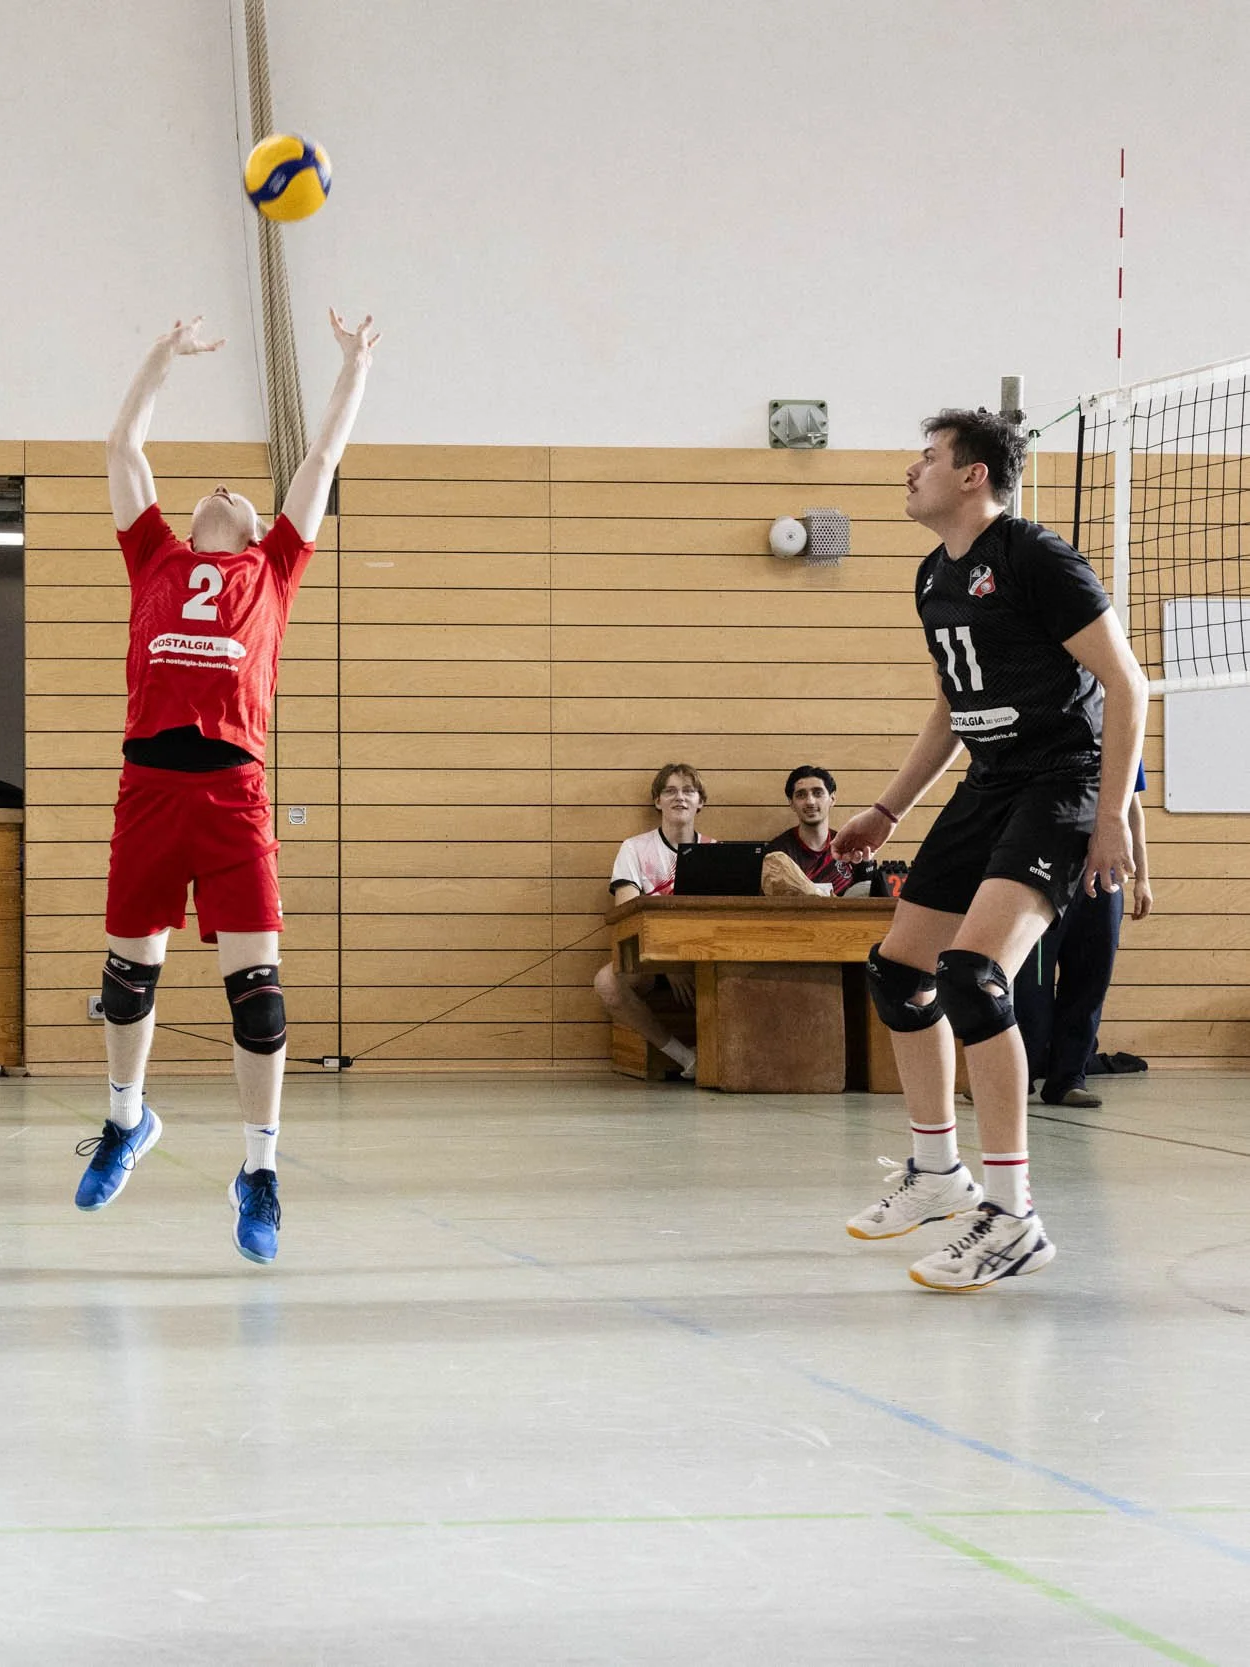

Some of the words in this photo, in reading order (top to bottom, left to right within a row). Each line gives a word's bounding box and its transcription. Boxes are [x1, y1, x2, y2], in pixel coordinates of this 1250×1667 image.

[182, 563, 223, 622] 2
[153, 638, 214, 651] NOSTALGIA
[935, 626, 984, 692] 11
[1029, 865, 1052, 881] erima
